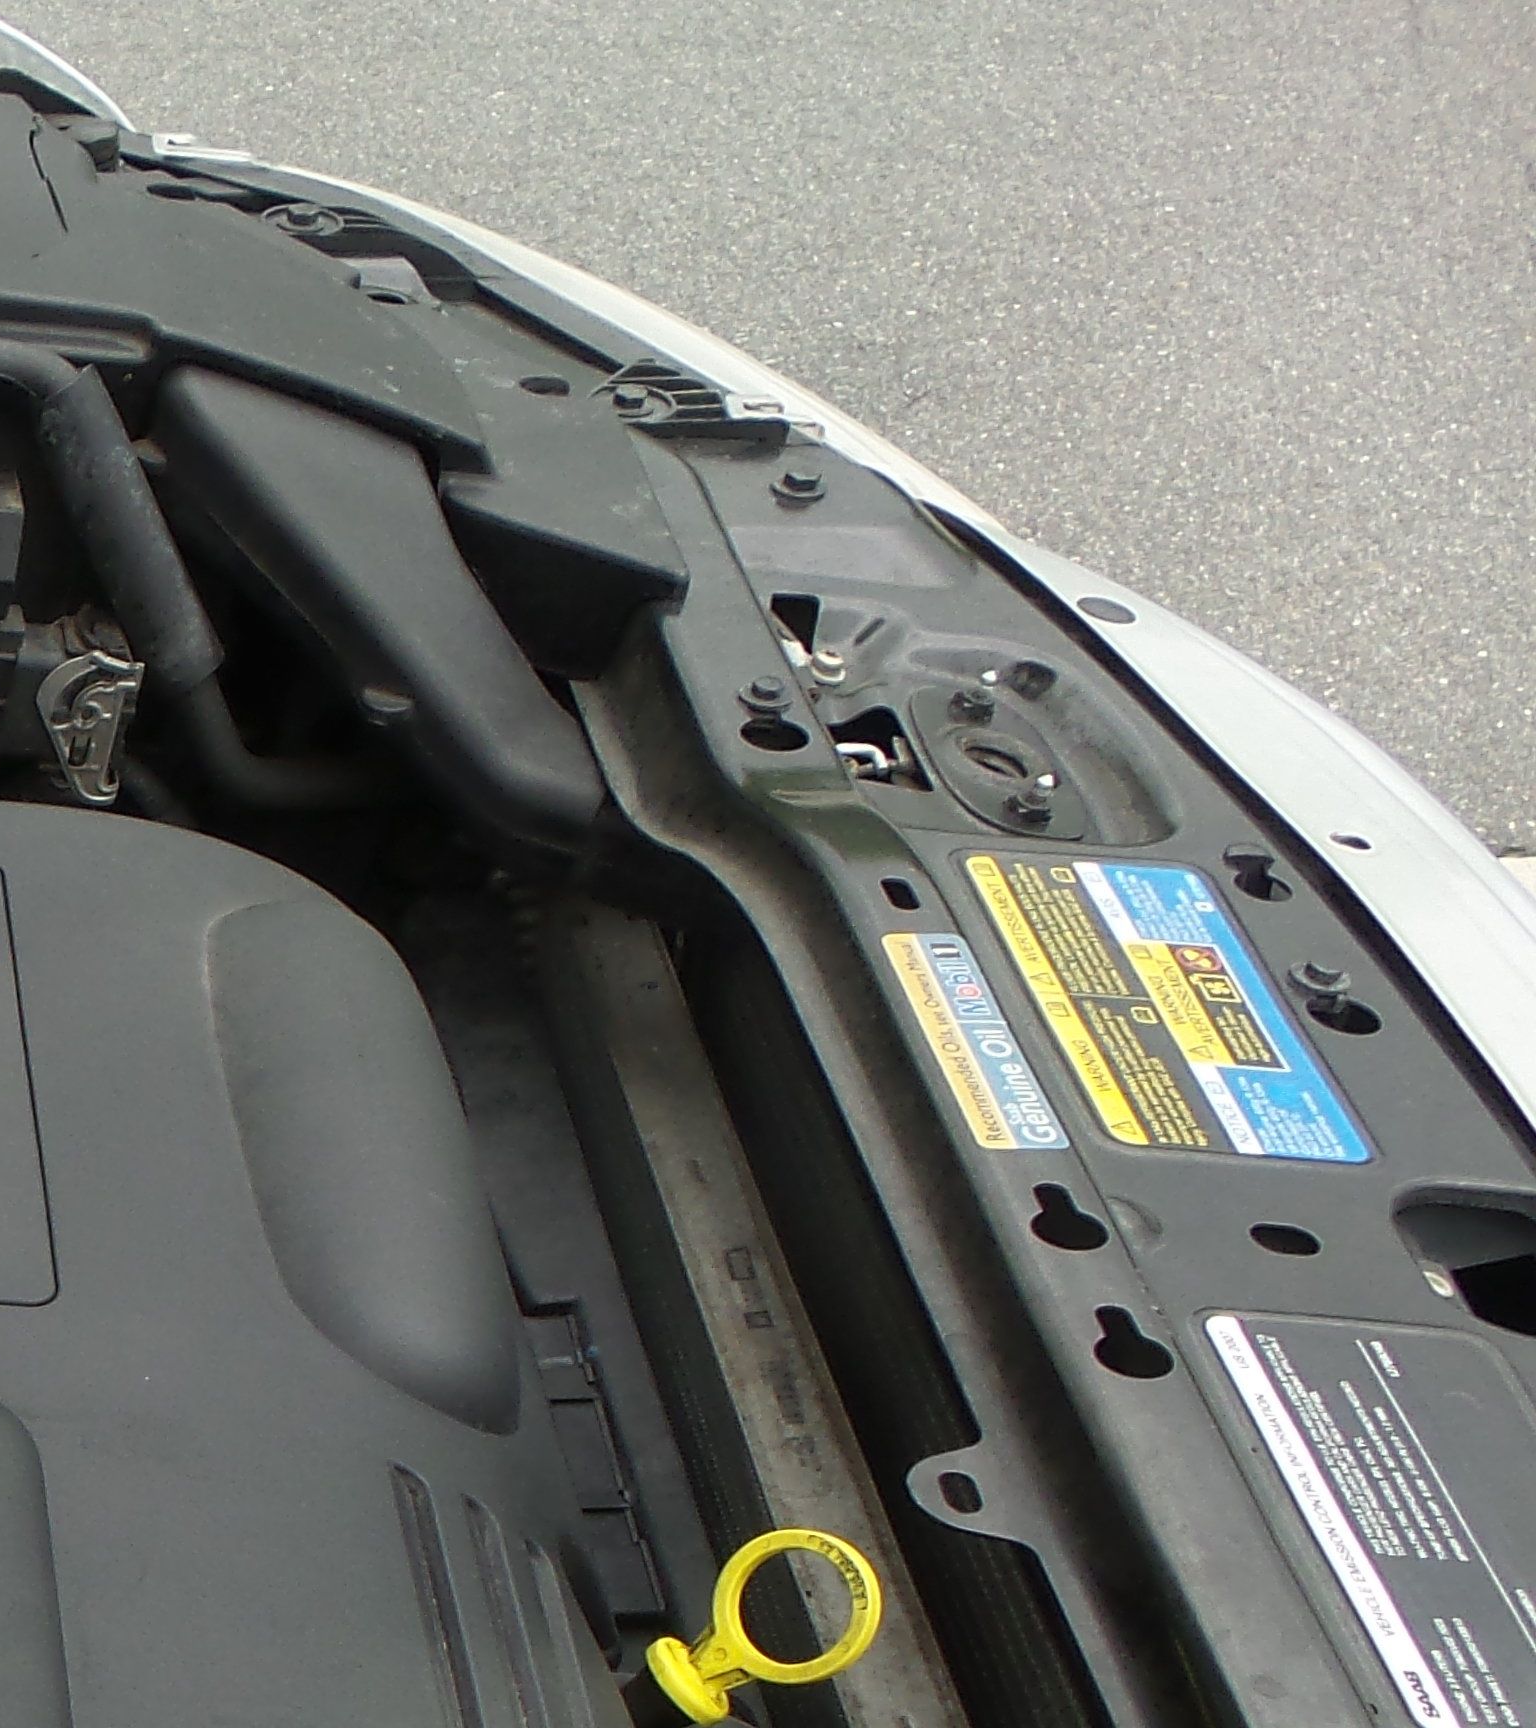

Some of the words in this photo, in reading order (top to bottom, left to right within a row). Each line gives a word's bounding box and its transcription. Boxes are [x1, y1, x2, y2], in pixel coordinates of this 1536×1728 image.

[935, 962, 993, 1015] Mobil
[1146, 975, 1188, 1025] WARNING
[971, 1029, 1016, 1057] Oil
[1071, 1039, 1113, 1092] WARNING
[948, 1056, 1005, 1140] Recommended
[989, 1064, 1061, 1142] Genuine
[1215, 1102, 1253, 1144] NOTICE
[1401, 1670, 1442, 1718] SAAB
